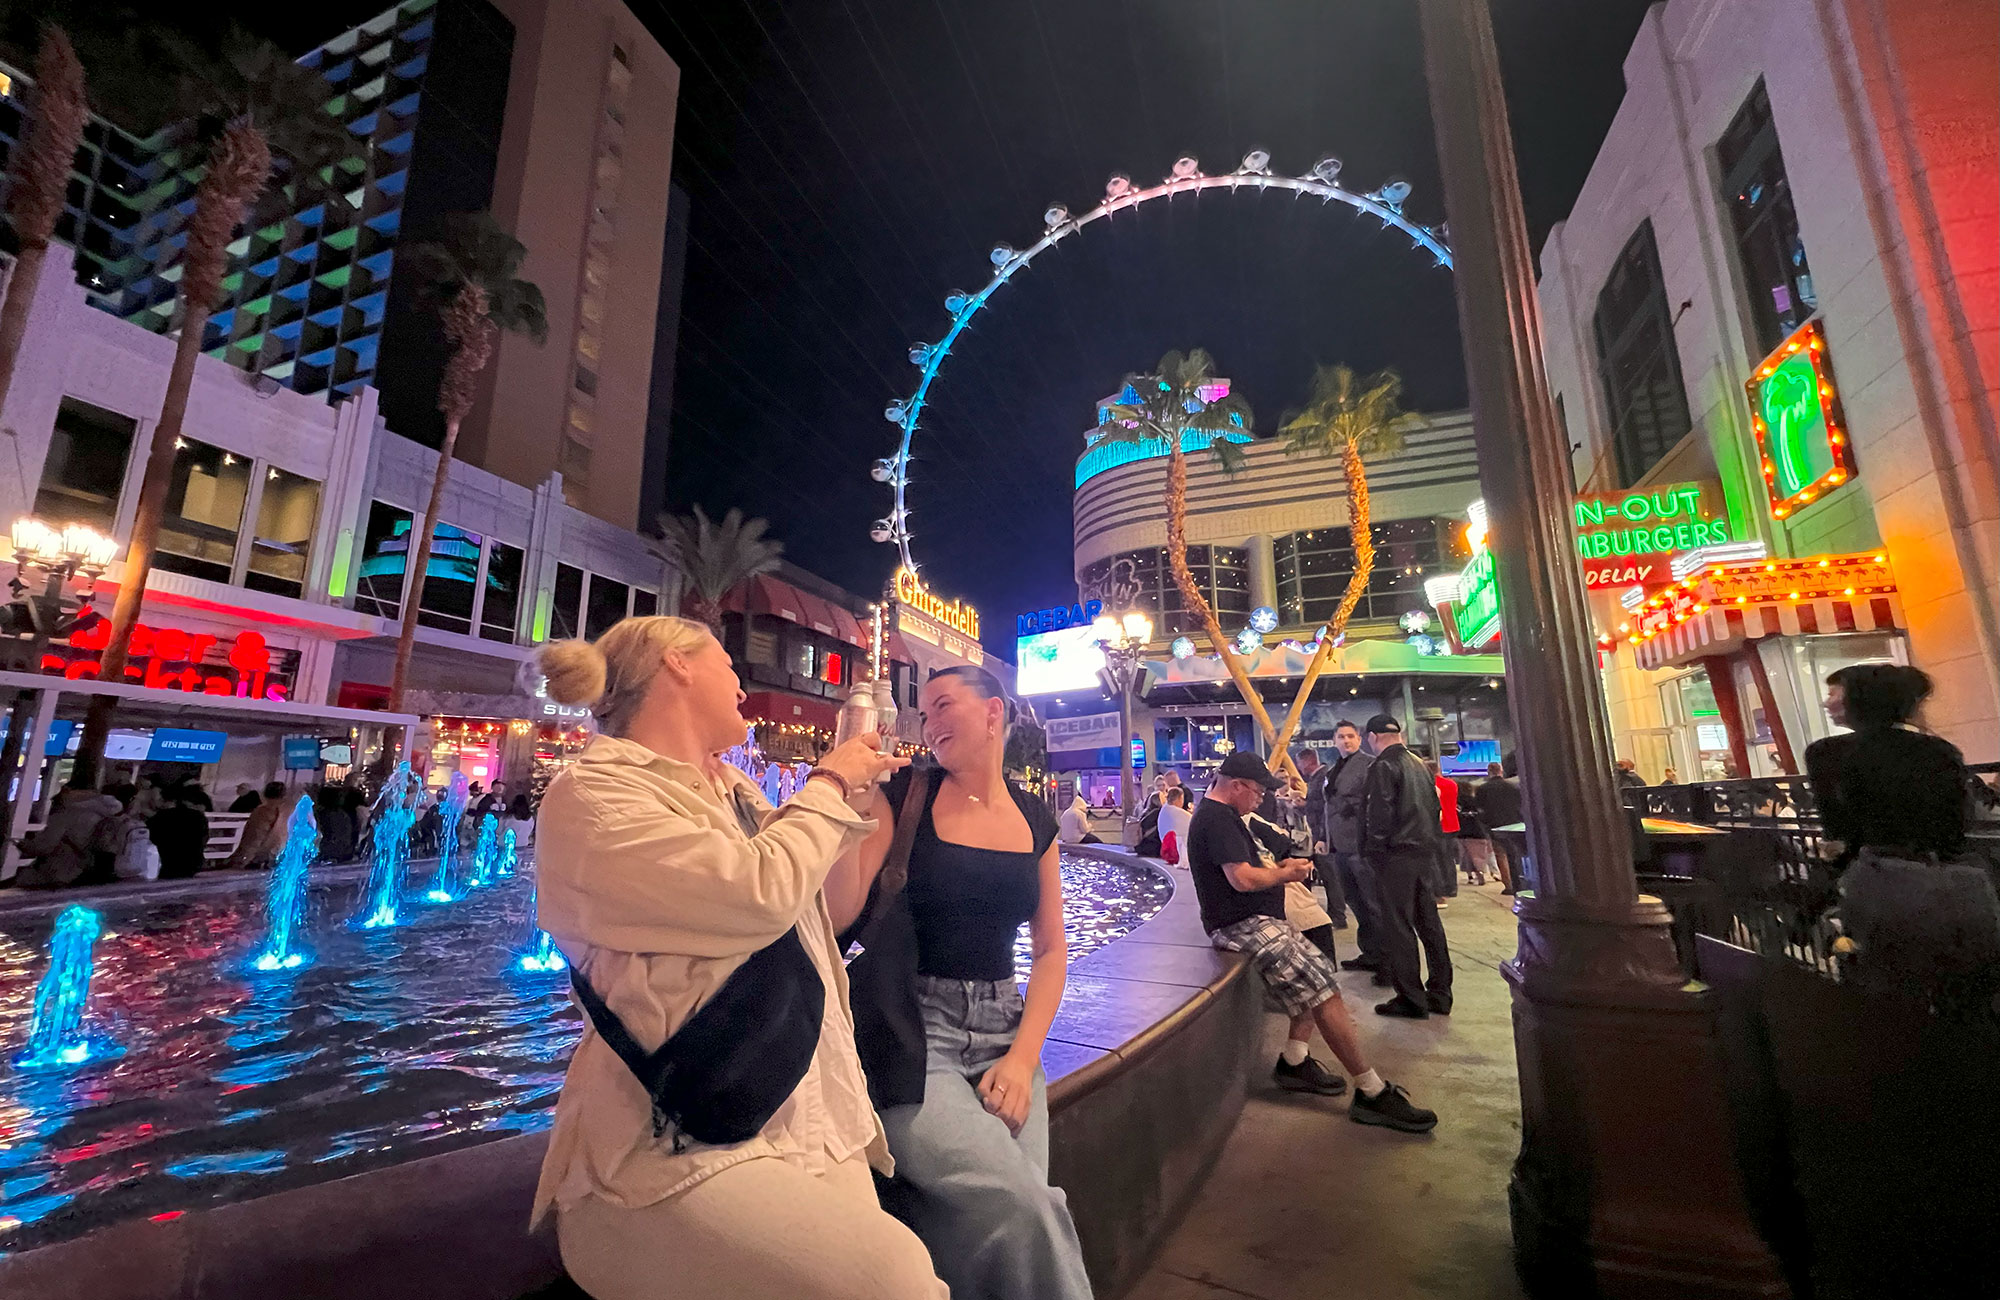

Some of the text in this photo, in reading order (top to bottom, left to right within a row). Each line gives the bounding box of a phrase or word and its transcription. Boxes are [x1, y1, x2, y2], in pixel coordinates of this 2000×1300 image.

[1575, 489, 1700, 527] N-OUT
[1585, 565, 1652, 585] DELAY
[896, 566, 980, 641] Ghirardelli
[1017, 599, 1103, 635] ICEBAR
[544, 704, 592, 716] SUS
[1049, 715, 1118, 734] ICEBAR
[1305, 739, 1337, 748] ICEB
